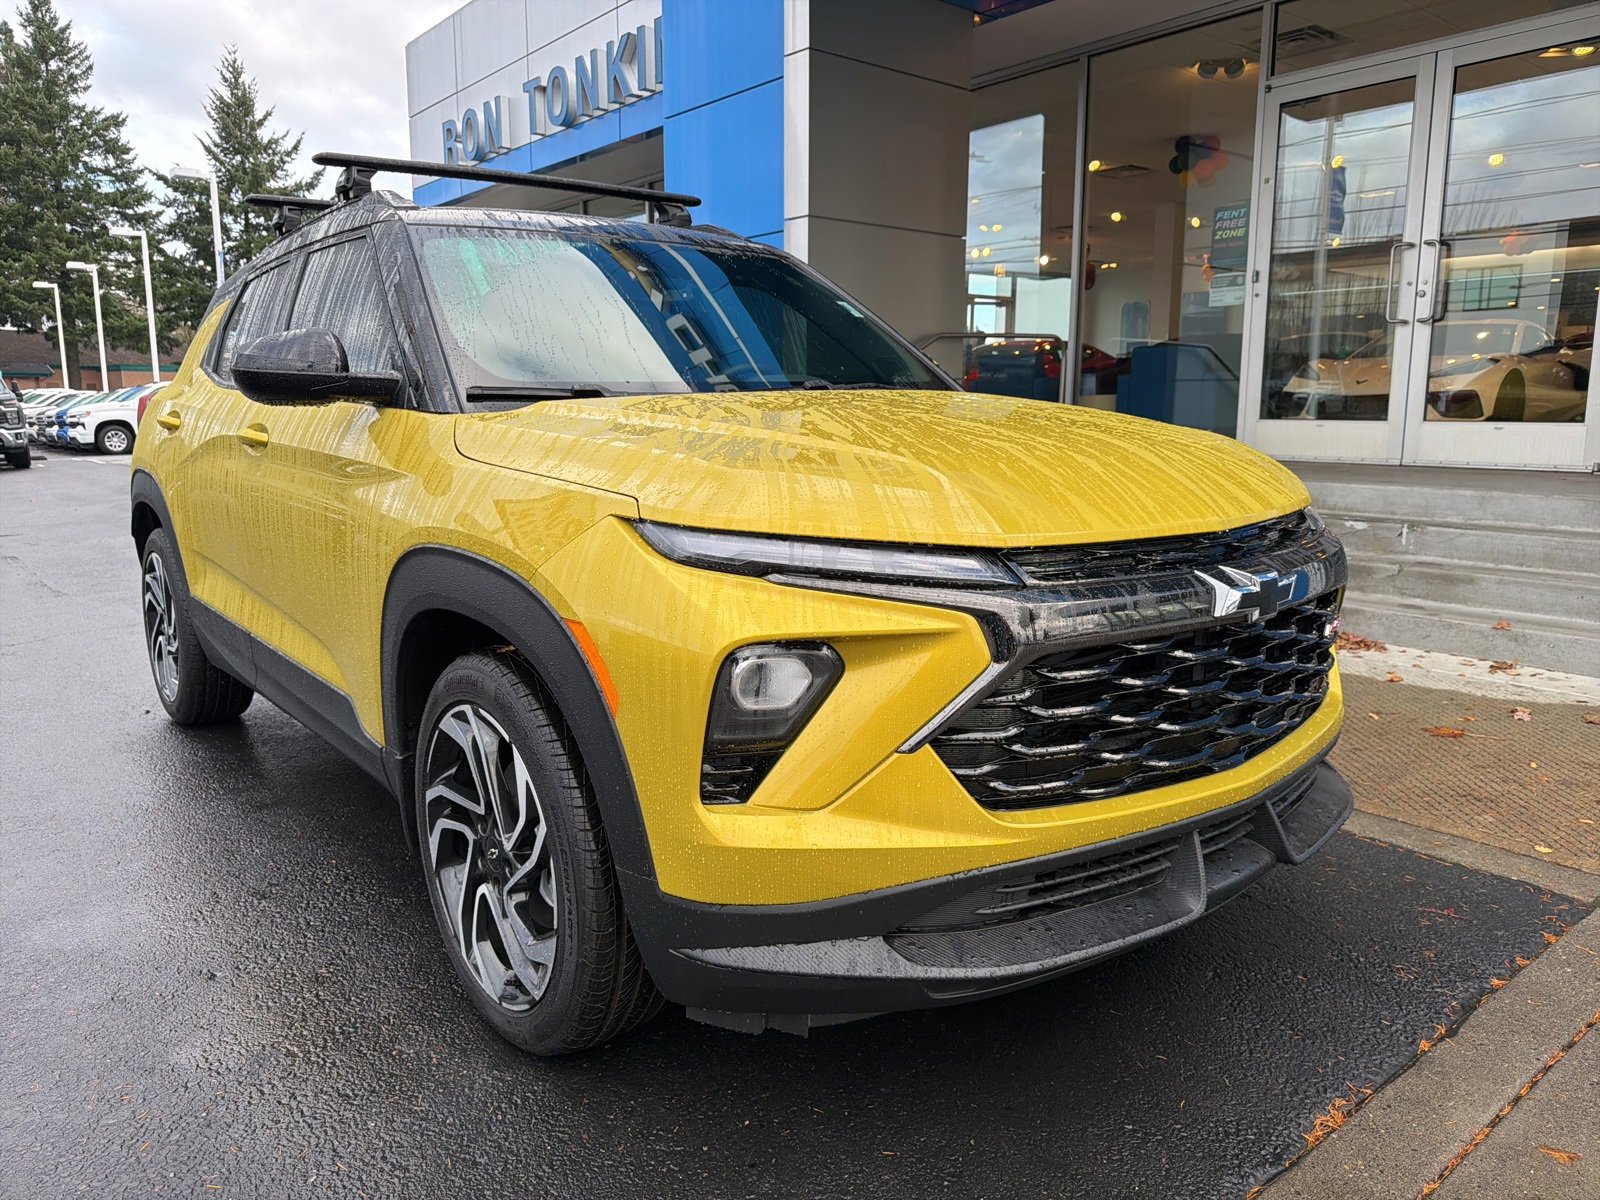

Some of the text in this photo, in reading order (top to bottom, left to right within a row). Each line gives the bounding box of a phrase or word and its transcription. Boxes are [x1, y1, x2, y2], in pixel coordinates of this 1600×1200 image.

[442, 16, 662, 165] RON TONKI
[1216, 208, 1247, 220] FENT
[1215, 218, 1246, 230] FREE
[1214, 228, 1246, 240] ZONE
